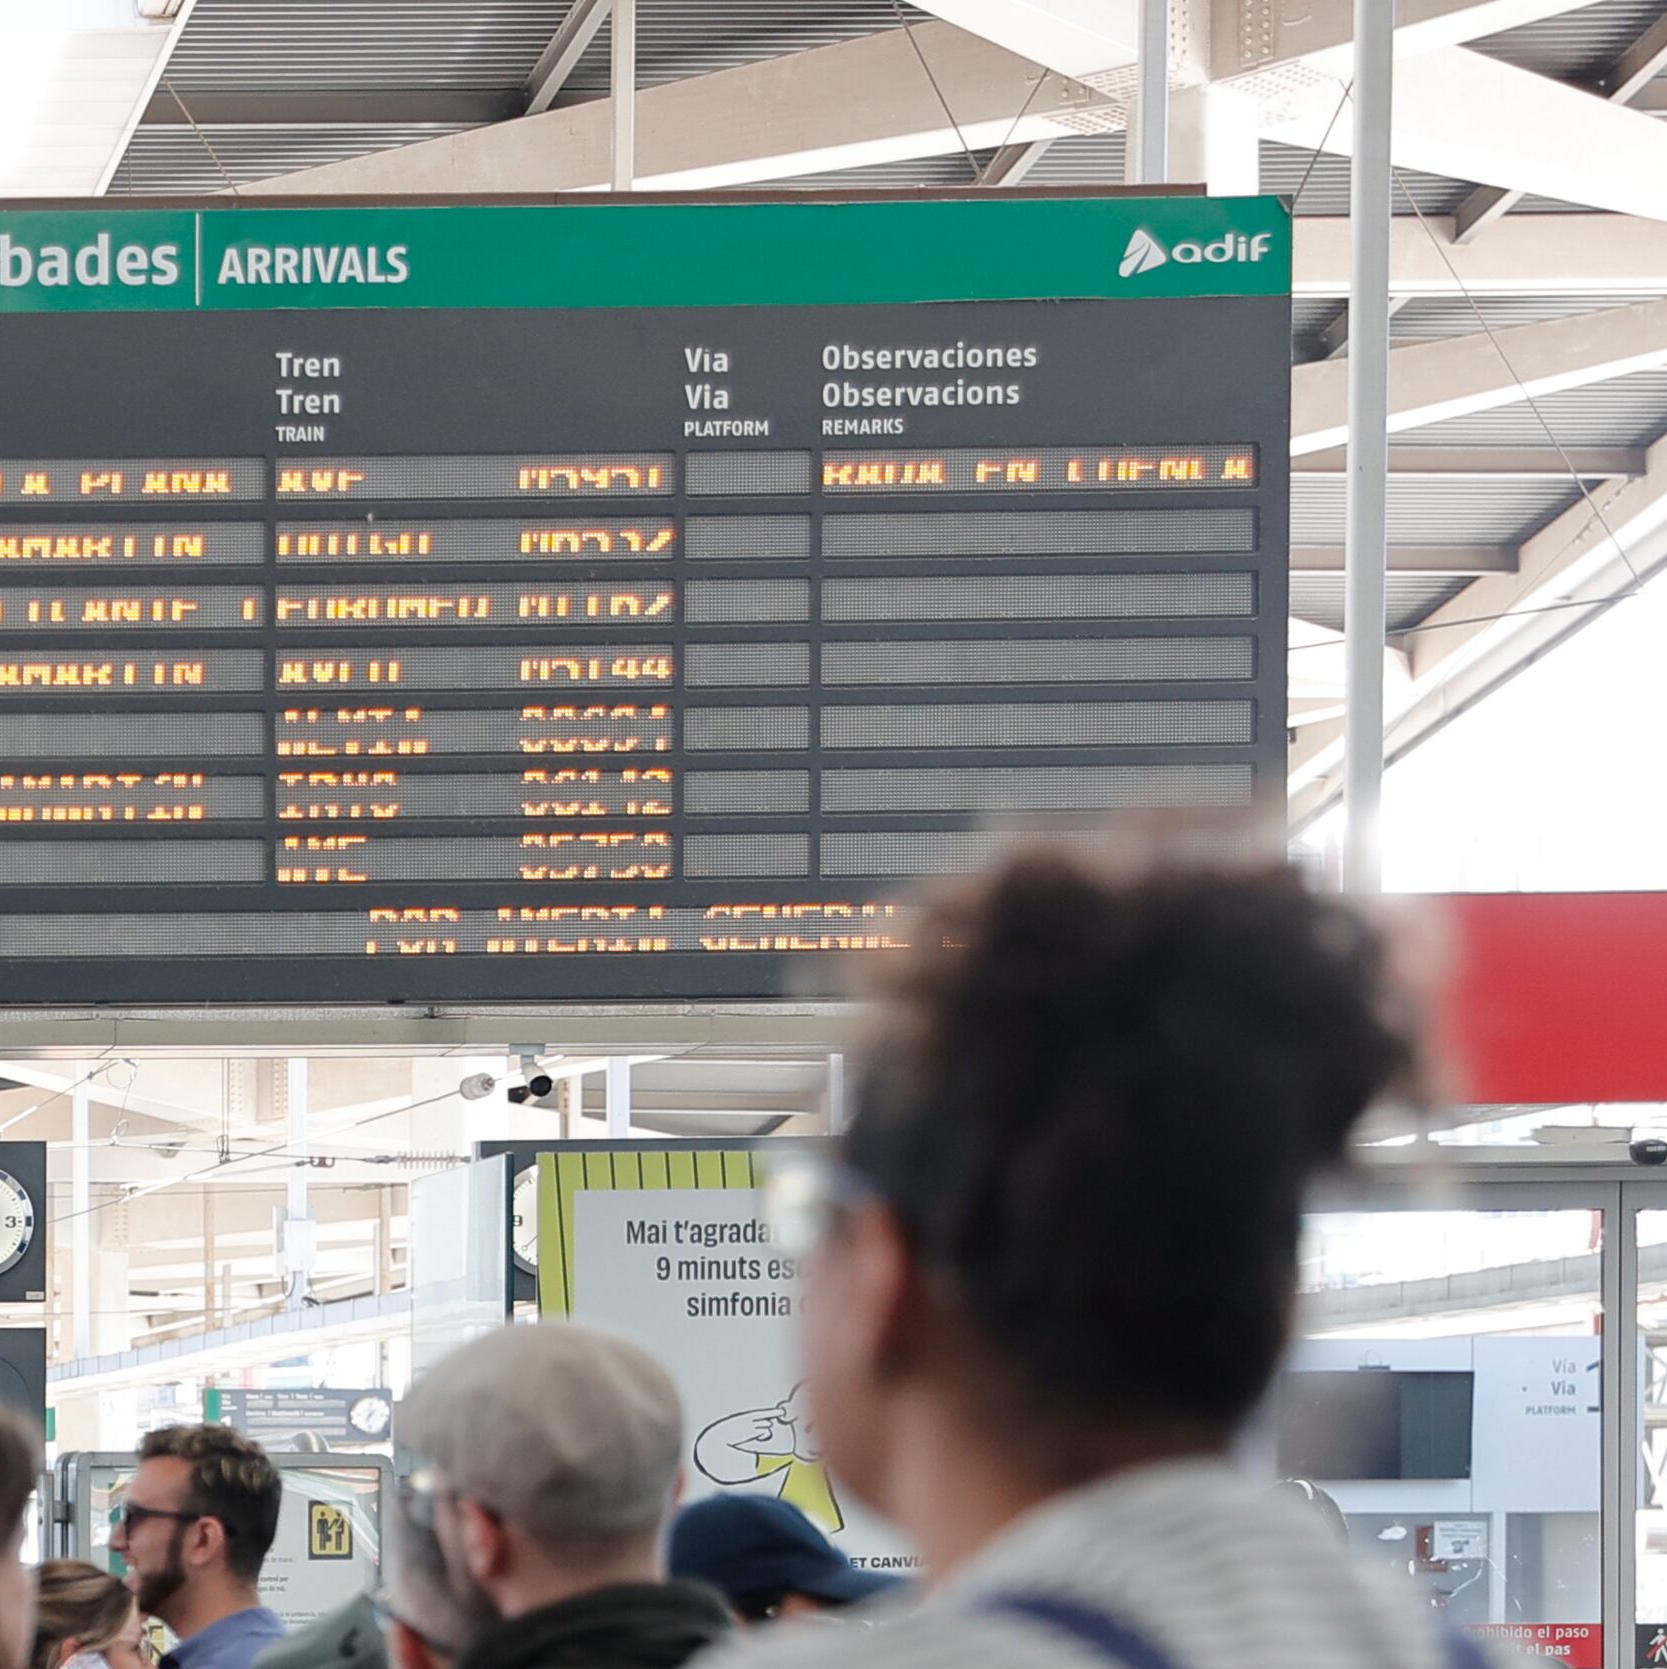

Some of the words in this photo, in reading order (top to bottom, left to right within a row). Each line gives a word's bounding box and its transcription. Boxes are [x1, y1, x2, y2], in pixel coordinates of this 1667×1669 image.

[1171, 232, 1271, 264] adif
[217, 245, 408, 285] ARRIVALS
[275, 352, 340, 378] Tren
[822, 341, 1037, 370] Observaciones
[275, 388, 340, 414] Tren
[684, 383, 729, 410] Via
[822, 378, 1020, 408] Observacions
[275, 425, 325, 442] TRAIN
[684, 420, 769, 437] PLATFORM
[822, 418, 904, 435] REMARKS
[626, 1219, 667, 1244] Mai
[674, 1218, 769, 1248] t'agrada
[656, 1256, 671, 1281] 9
[678, 1256, 761, 1281] minuts
[768, 1259, 796, 1280] es
[687, 1293, 791, 1316] simfonia
